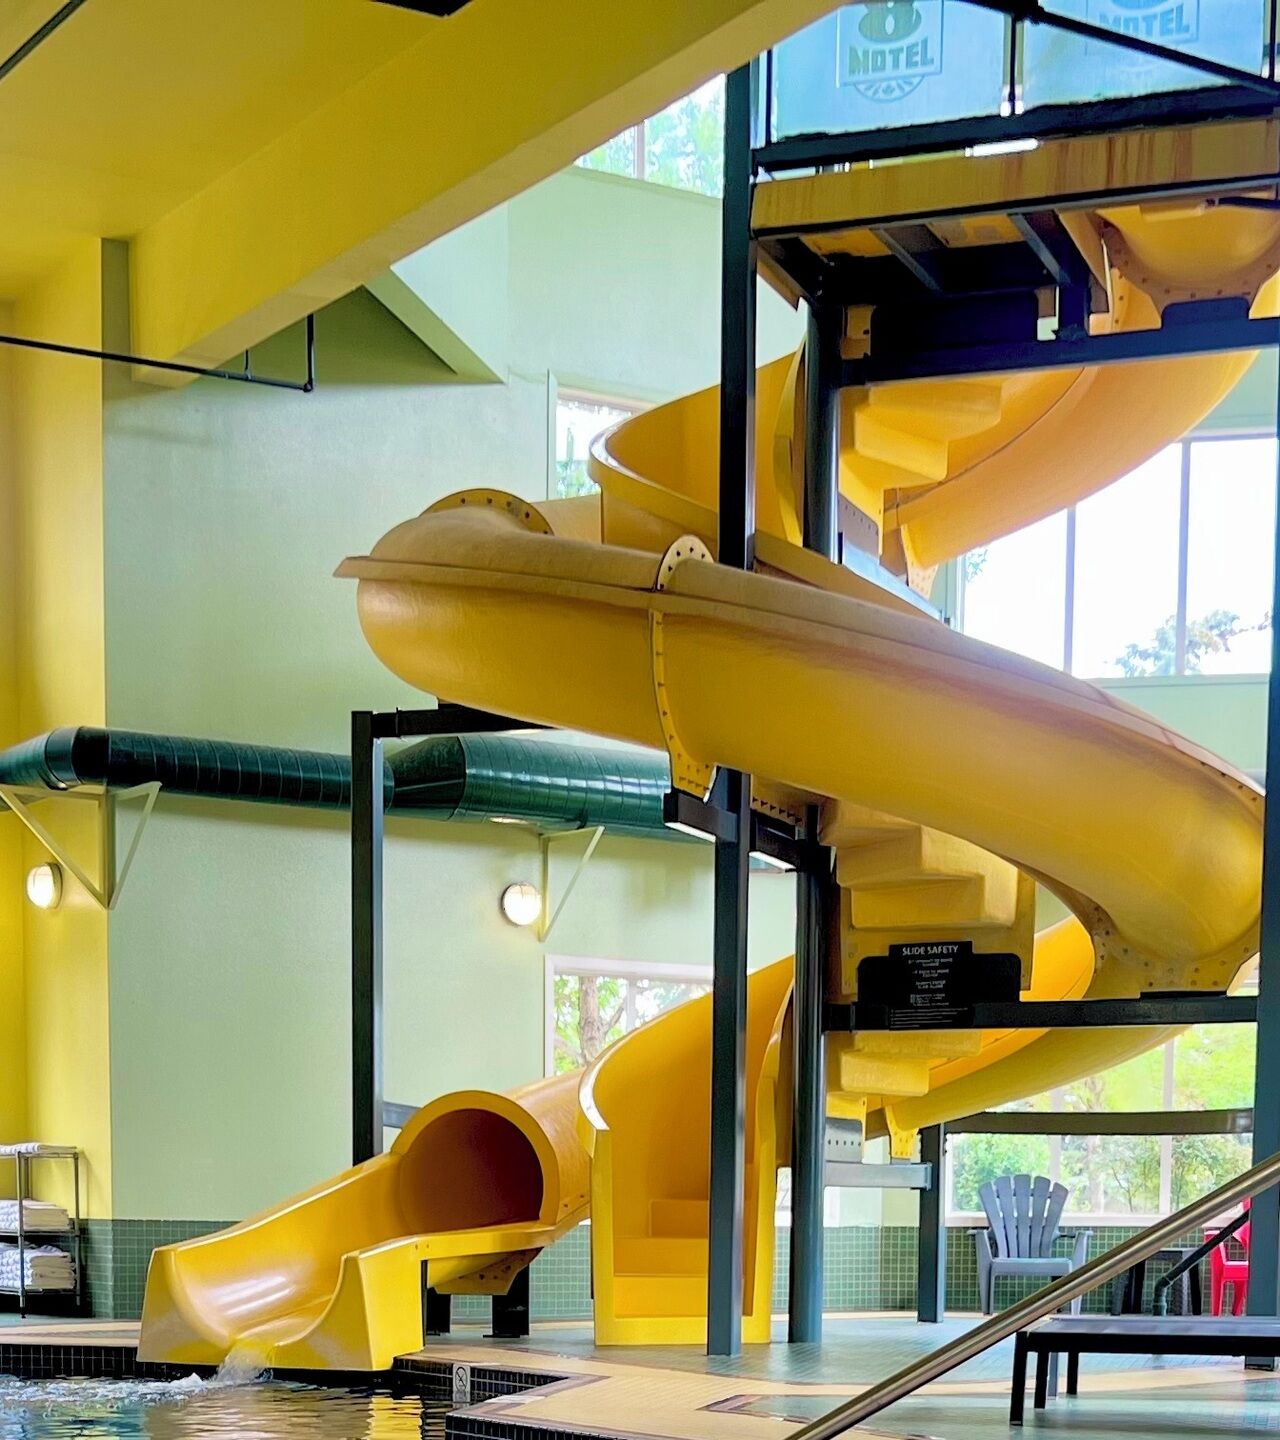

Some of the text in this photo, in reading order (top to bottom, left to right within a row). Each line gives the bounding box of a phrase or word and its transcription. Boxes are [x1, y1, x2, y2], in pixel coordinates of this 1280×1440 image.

[1098, 4, 1190, 37] MOTEL
[848, 36, 935, 77] MOTEL
[902, 945, 959, 956] SLIDE SAFETY
